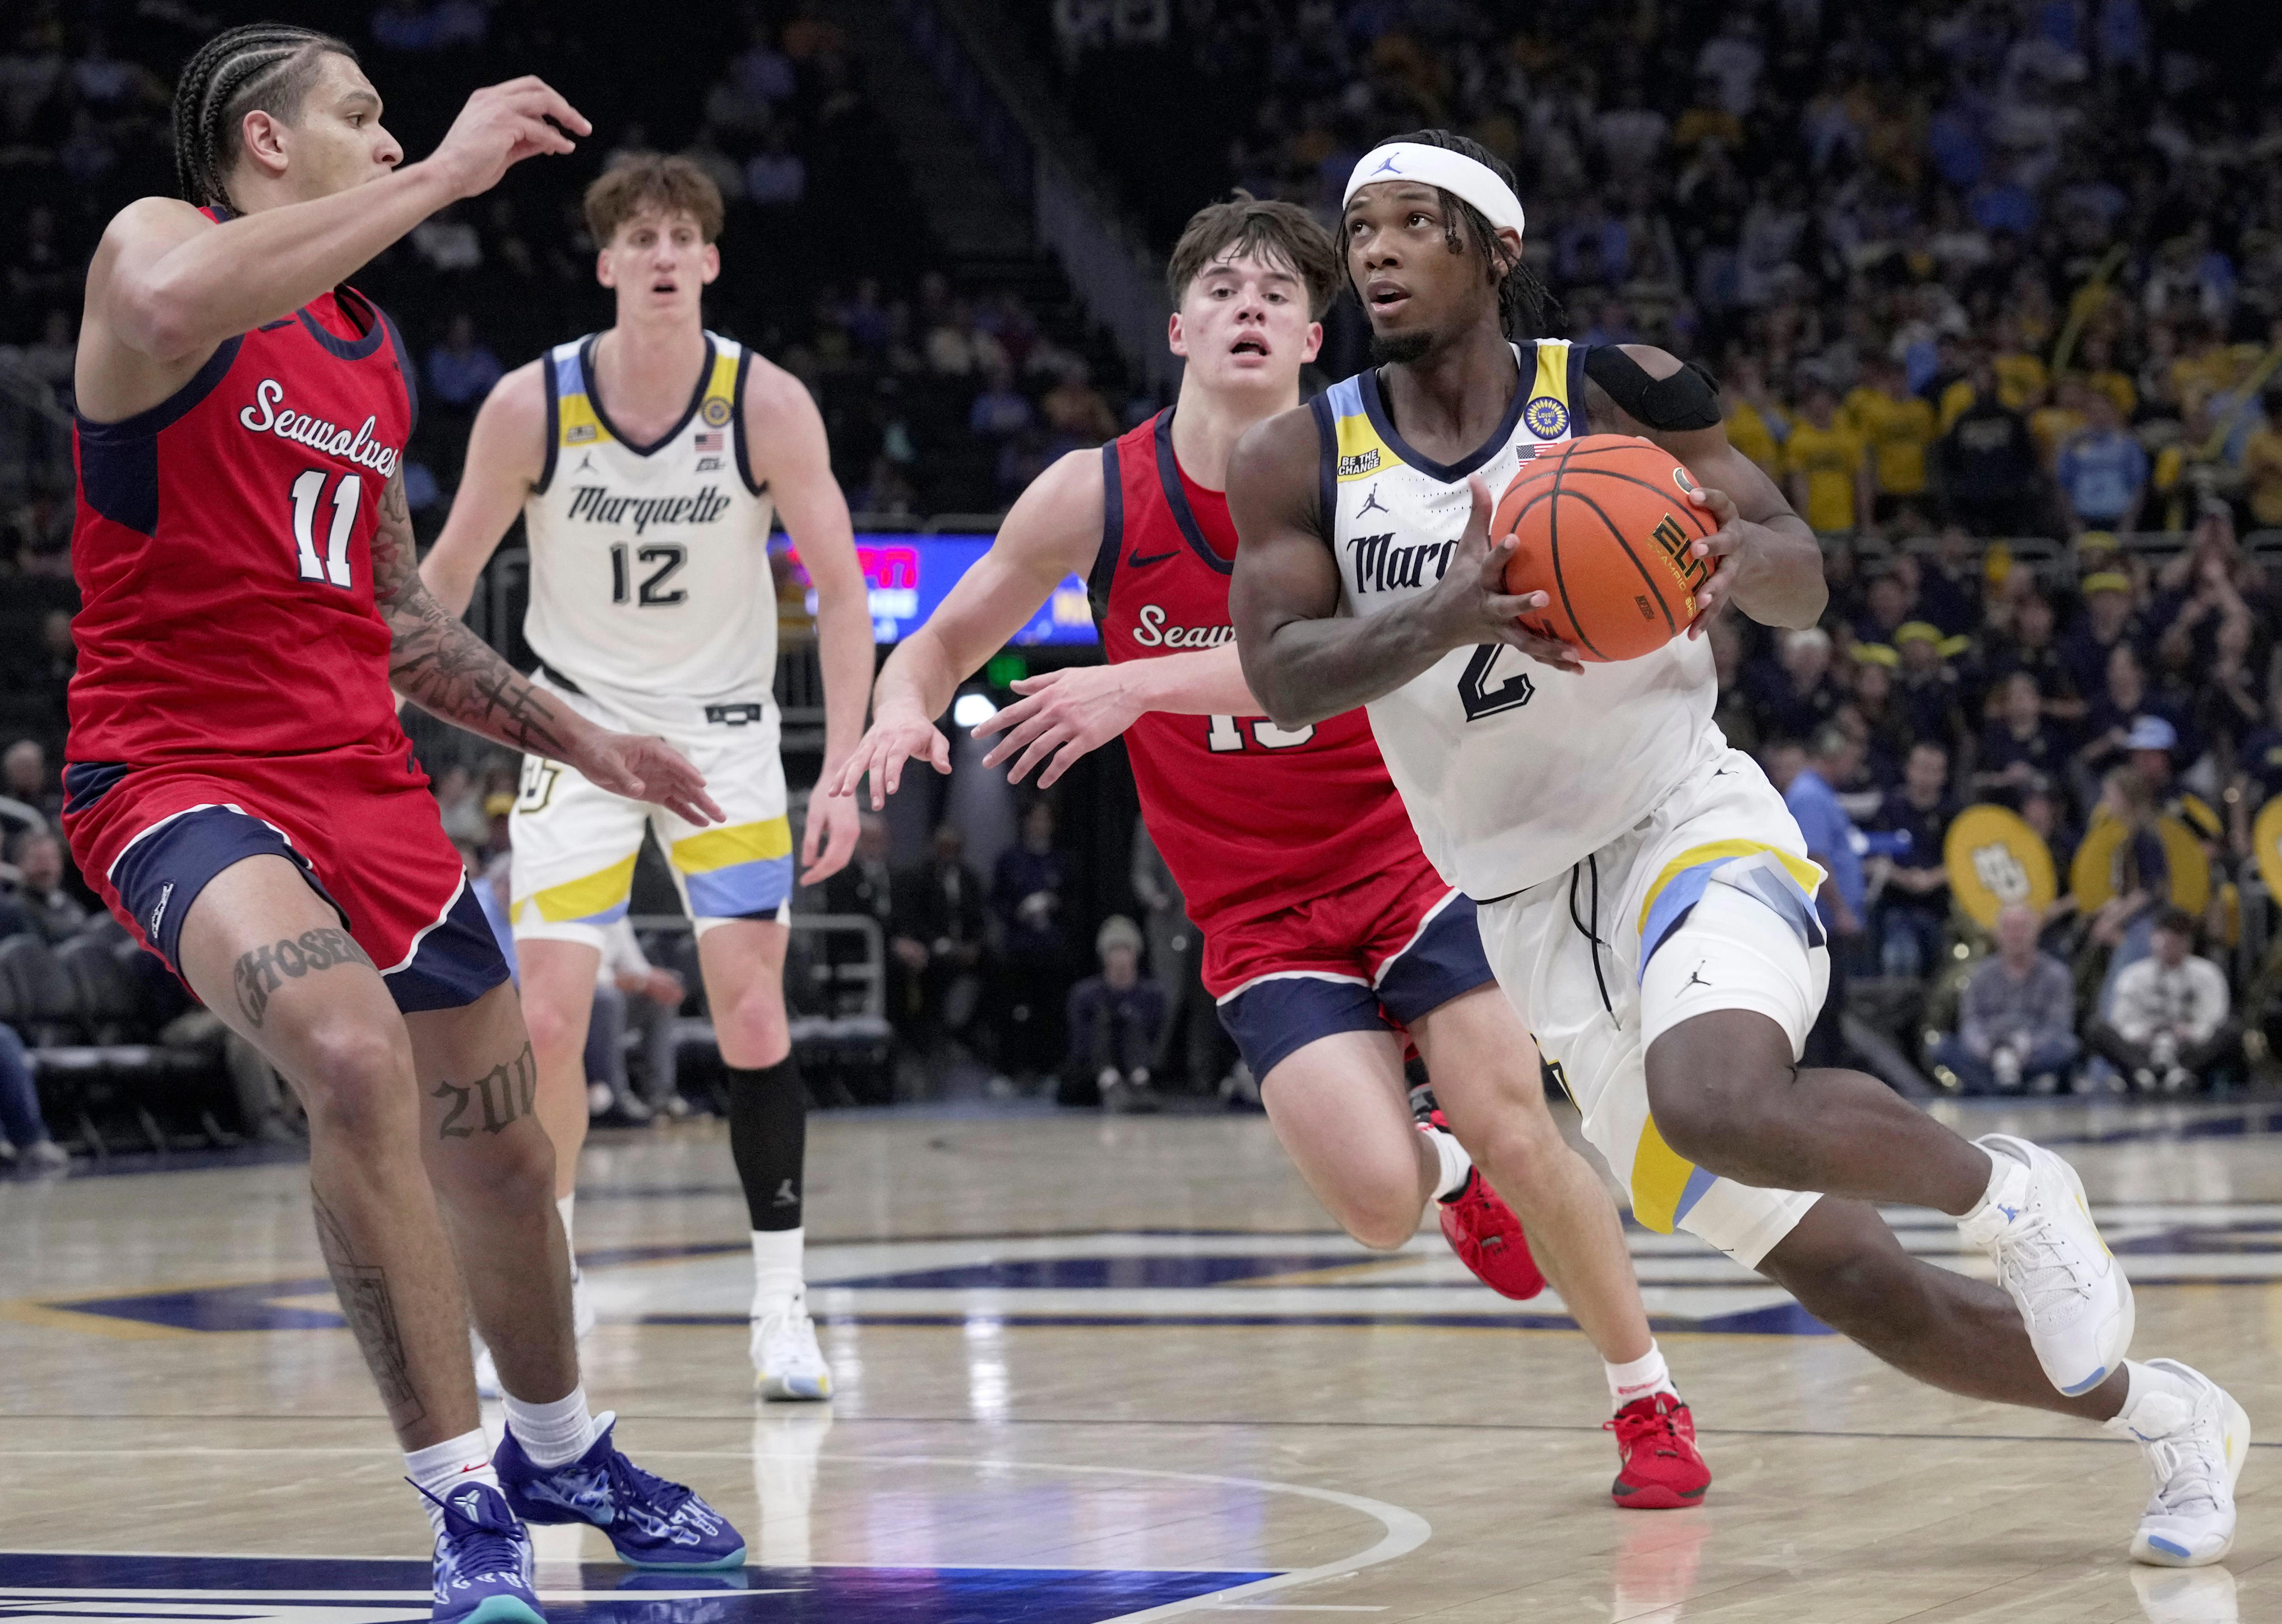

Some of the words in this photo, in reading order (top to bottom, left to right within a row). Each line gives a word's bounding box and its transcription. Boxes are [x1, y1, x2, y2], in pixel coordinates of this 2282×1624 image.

[239, 378, 399, 478] Seawolves
[1341, 456, 1356, 466] BE
[1359, 449, 1377, 465] THE
[1338, 457, 1380, 476] CHANGE
[289, 467, 362, 591] 11
[567, 484, 731, 536] Marquette
[609, 540, 689, 607] 12
[1645, 536, 1693, 619] CHAMPIOSHIP
[1457, 644, 1535, 722] 2
